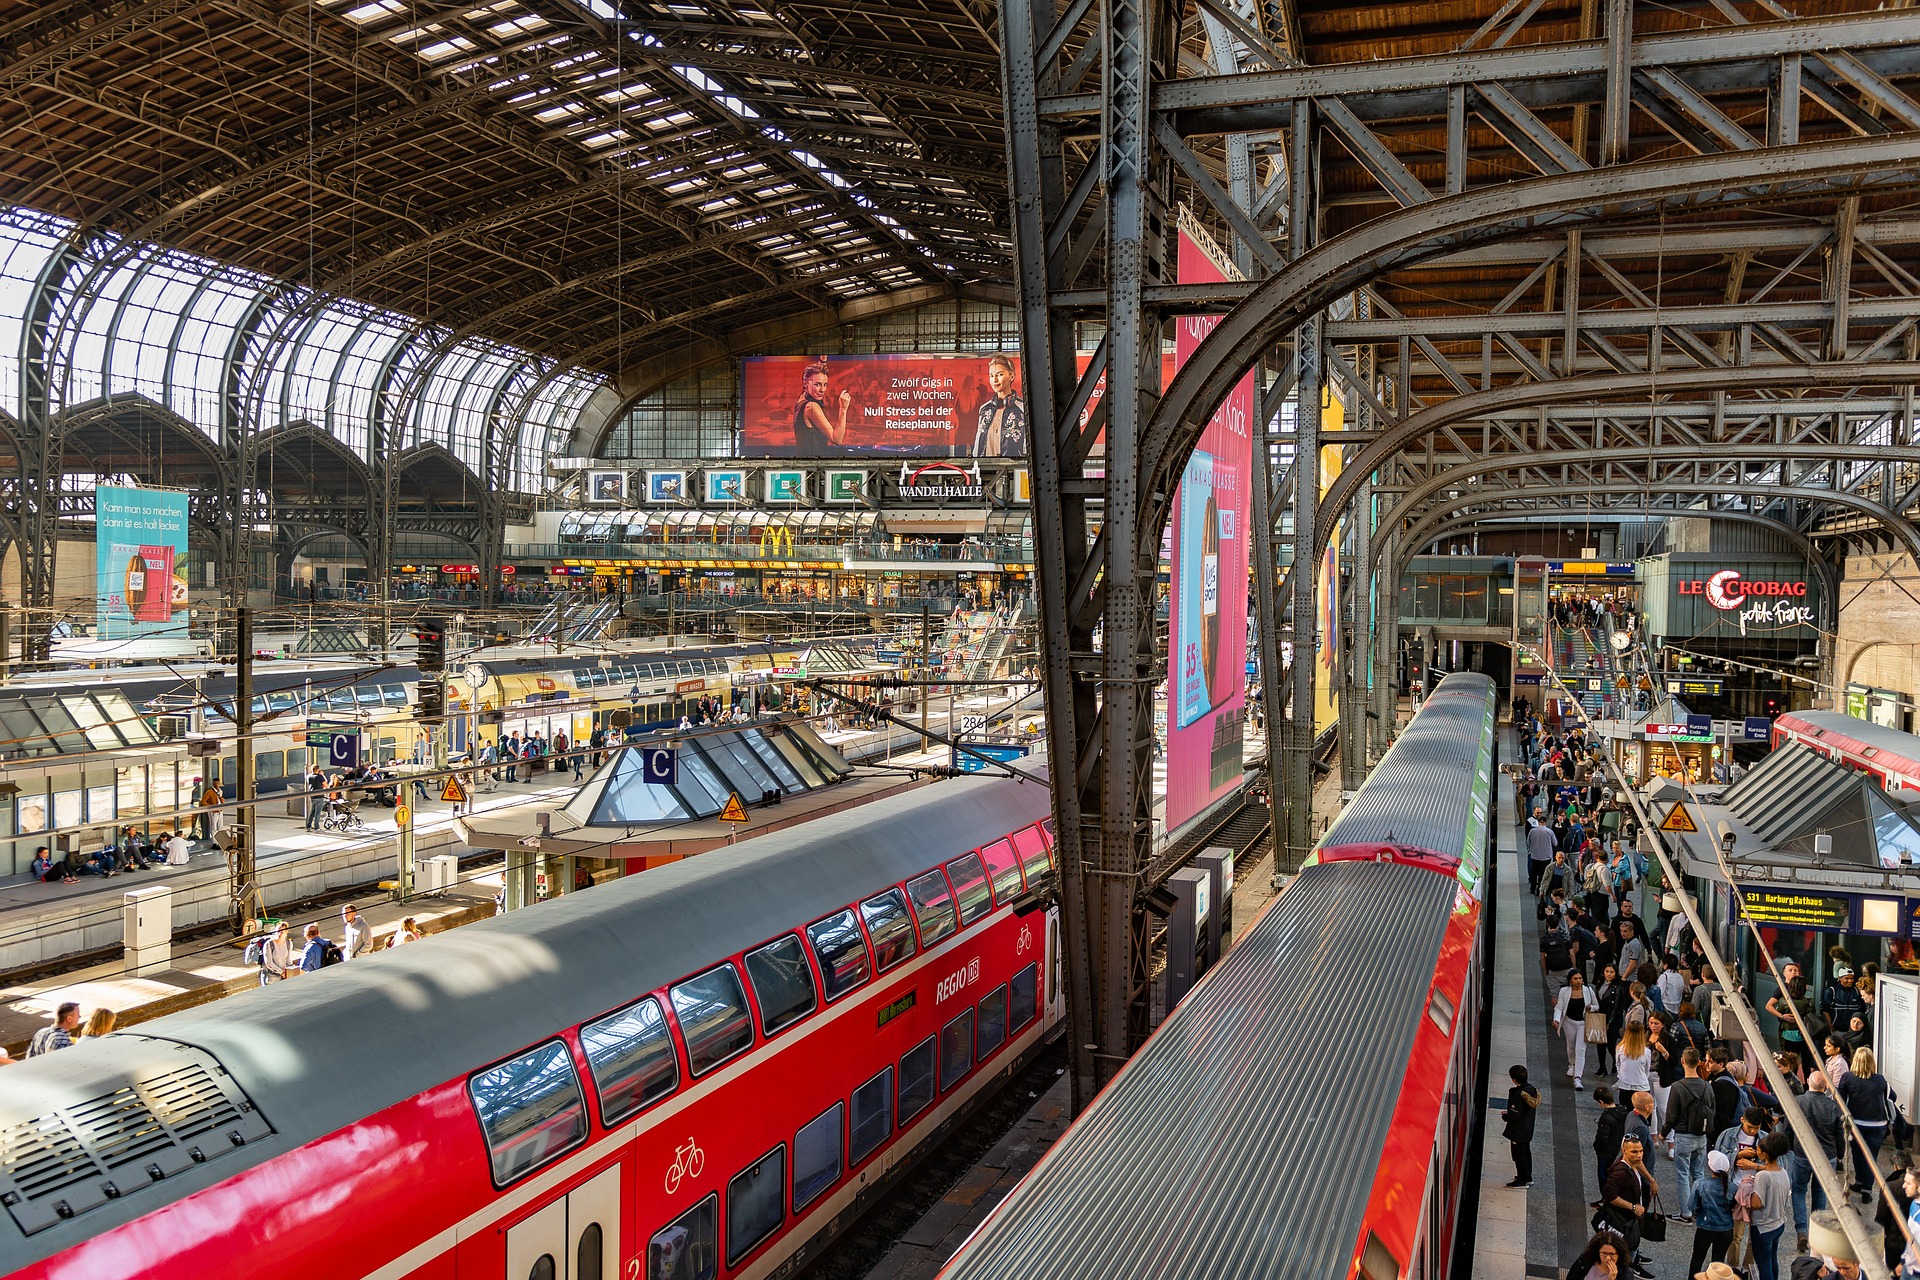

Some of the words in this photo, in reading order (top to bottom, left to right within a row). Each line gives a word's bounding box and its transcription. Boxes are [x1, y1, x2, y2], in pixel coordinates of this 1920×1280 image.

[891, 378, 919, 388] Zwölf
[921, 377, 942, 389] Gigs
[943, 377, 953, 387] in
[887, 390, 909, 400] zwei
[913, 390, 954, 400] Wochen.
[864, 406, 884, 416] Null
[886, 406, 916, 416] Stress
[918, 406, 934, 416] bei
[936, 406, 953, 416] der
[885, 419, 954, 431] Reiseplanung.
[1190, 466, 1212, 488] KAKAO
[1213, 471, 1235, 491] KLASSE
[898, 486, 982, 497] WANDELHALLE
[103, 501, 123, 513] Kann
[124, 506, 141, 514] man
[153, 505, 183, 518] machen,
[103, 516, 123, 527] dann
[144, 518, 157, 529] halt
[159, 518, 181, 531] lecker.
[1222, 513, 1233, 535] NEU
[1679, 581, 1703, 594] LE
[1725, 581, 1807, 596] CROBAG
[1772, 600, 1815, 625] France
[963, 717, 983, 729] 286
[1657, 725, 1687, 734] SPA
[333, 734, 348, 760] C
[652, 749, 670, 777] C
[1747, 892, 1760, 902] S31
[1765, 894, 1793, 906] Harburg
[1794, 896, 1823, 906] Rathaus
[936, 966, 967, 1005] REGIO
[968, 957, 979, 984] DB
